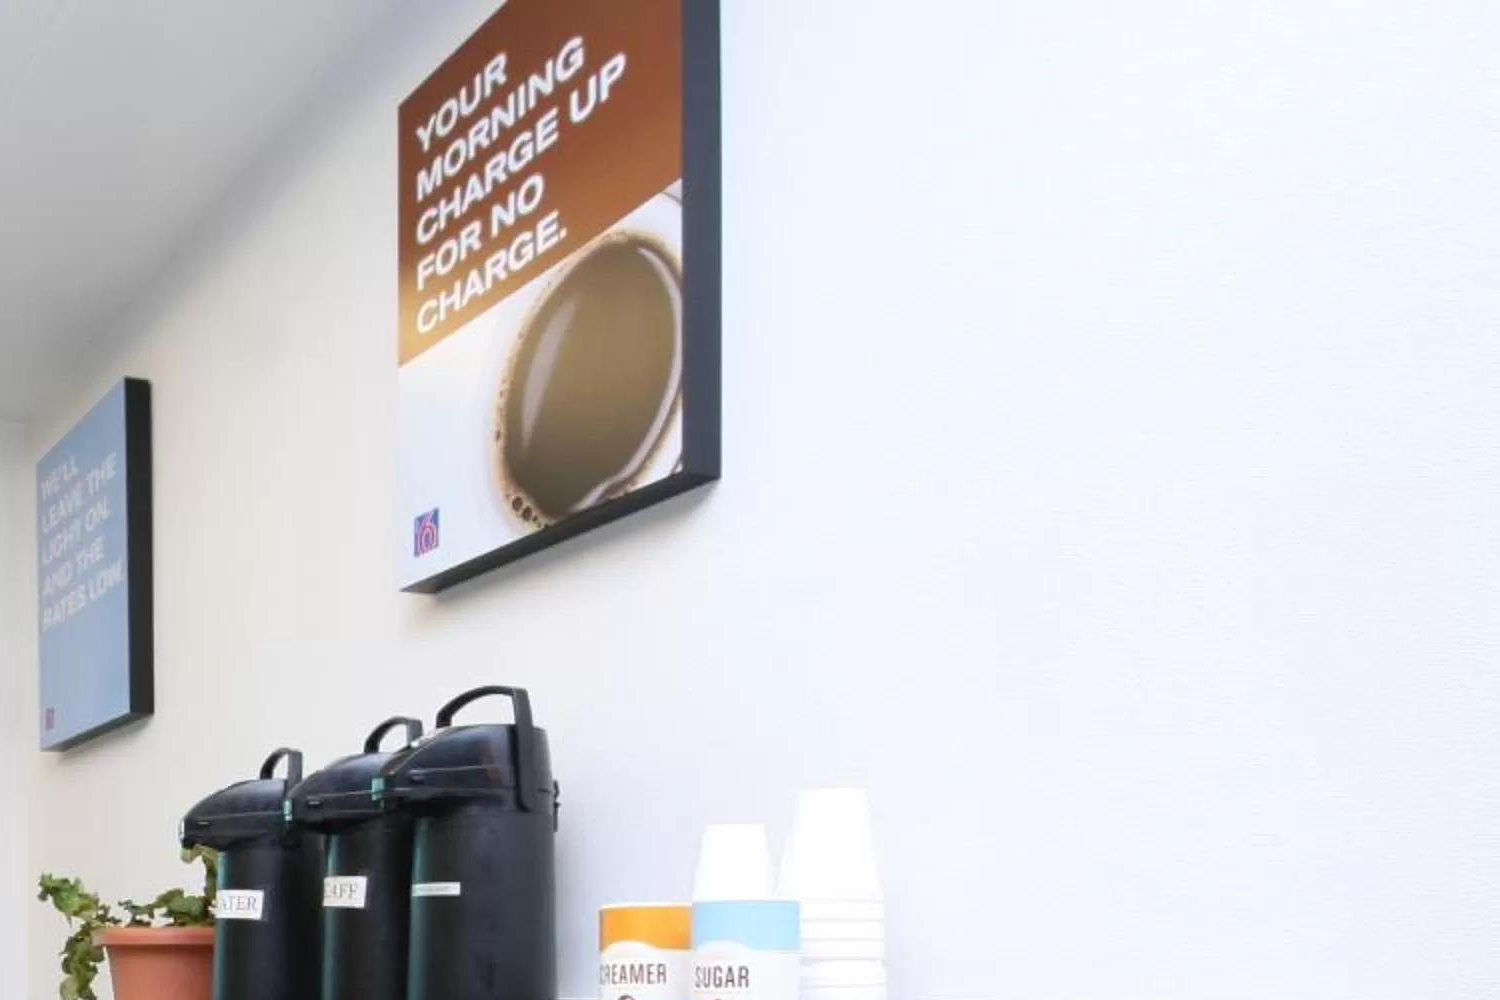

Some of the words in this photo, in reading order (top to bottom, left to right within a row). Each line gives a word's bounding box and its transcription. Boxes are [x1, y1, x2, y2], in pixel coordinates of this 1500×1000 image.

[416, 52, 507, 151] YOUR
[417, 36, 584, 202] MORNING
[417, 107, 560, 245] CHARGE
[570, 53, 627, 123] UP
[417, 220, 482, 292] FOR
[491, 173, 544, 239] NO
[417, 210, 567, 333] CHARGE.
[86, 451, 117, 497] THE
[85, 494, 109, 532] ON
[43, 559, 73, 603] AND
[74, 534, 105, 576] THE
[43, 584, 86, 632] RATES
[220, 894, 257, 912] ATER
[600, 963, 667, 985] CREAMER
[695, 965, 750, 988] SUGAR
